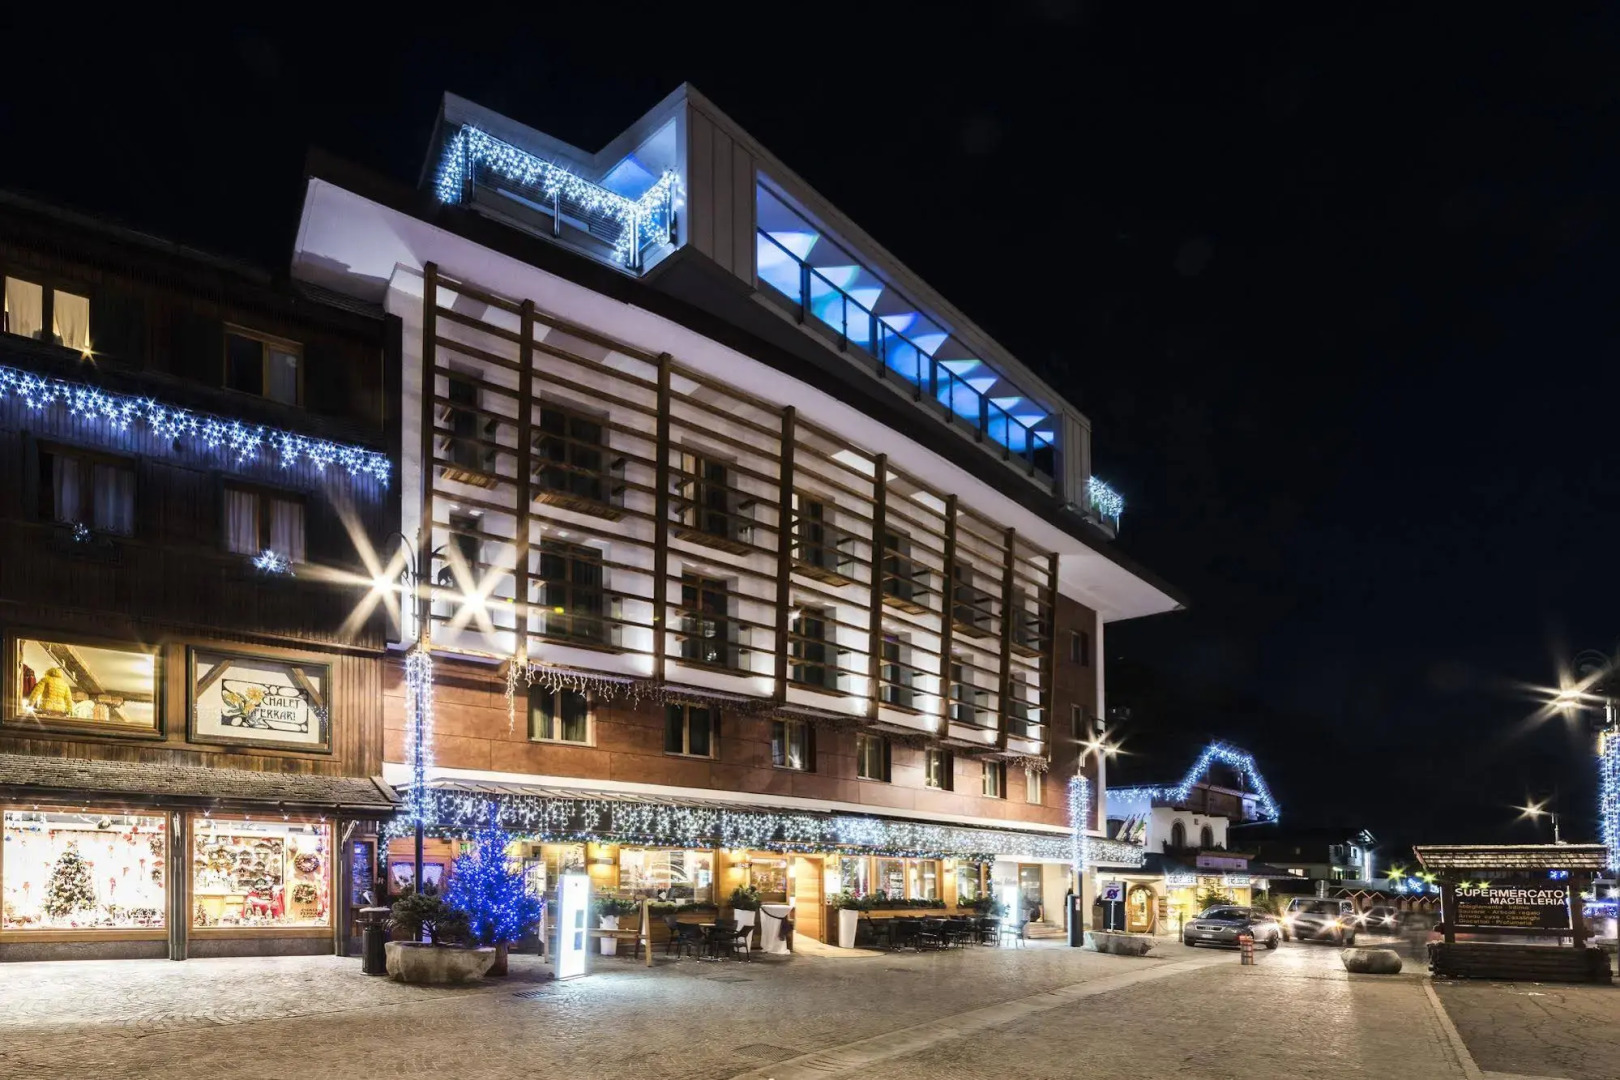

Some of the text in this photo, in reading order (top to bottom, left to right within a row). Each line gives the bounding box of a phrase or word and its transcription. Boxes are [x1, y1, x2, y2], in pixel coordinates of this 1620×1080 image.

[262, 696, 300, 709] CHALET
[254, 707, 296, 721] FERRARI
[1454, 888, 1564, 898] SUPERMERCATO
